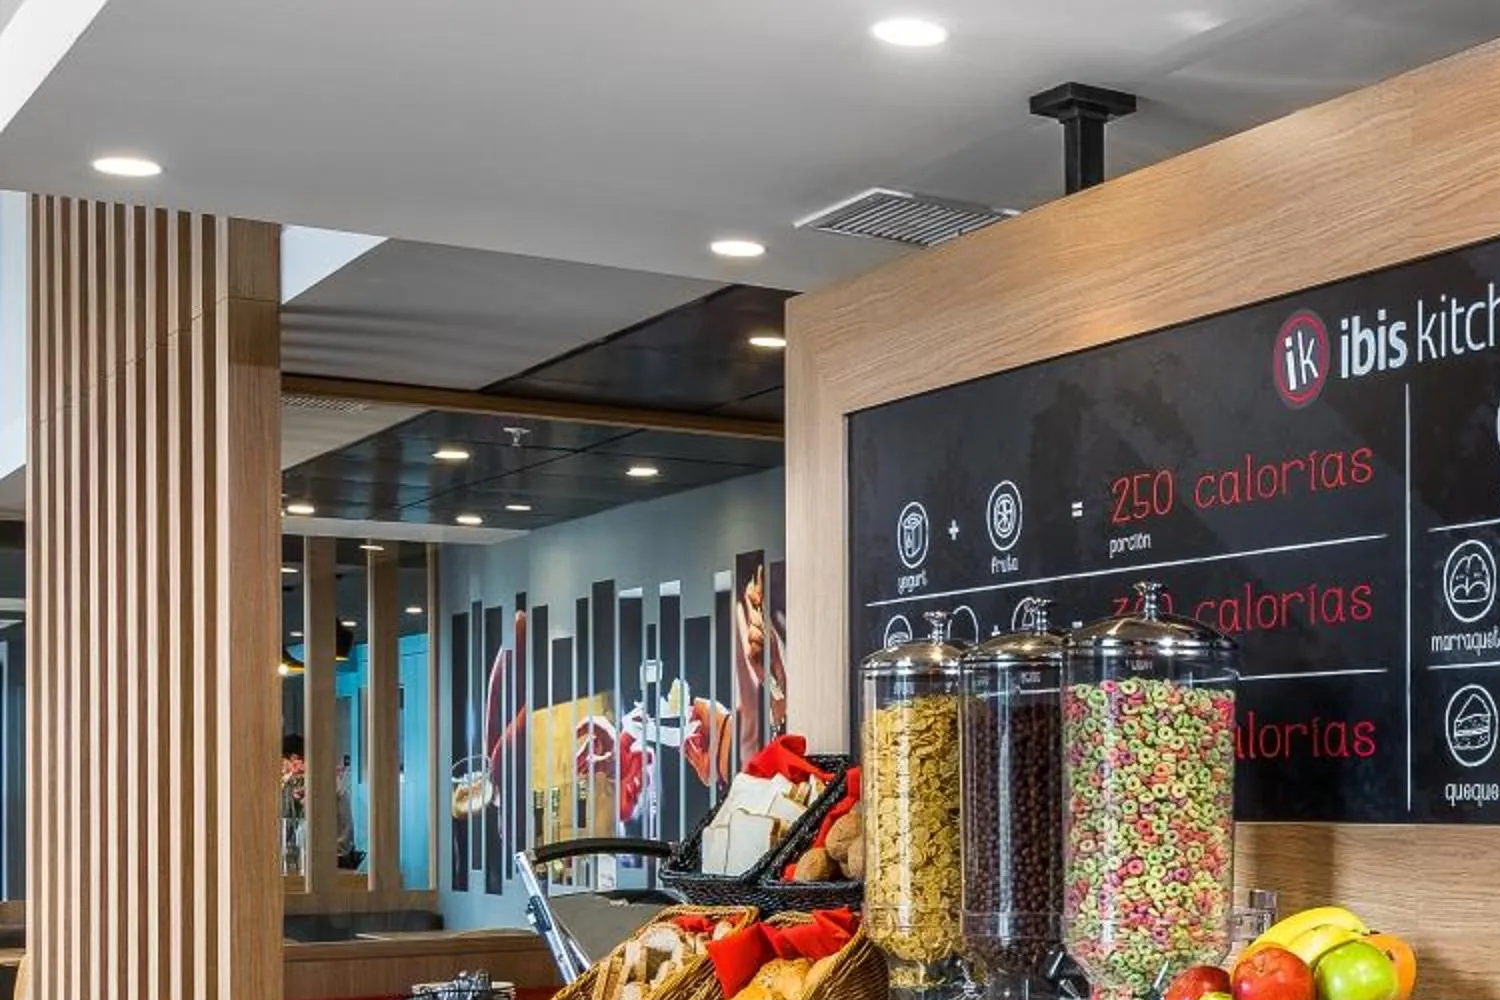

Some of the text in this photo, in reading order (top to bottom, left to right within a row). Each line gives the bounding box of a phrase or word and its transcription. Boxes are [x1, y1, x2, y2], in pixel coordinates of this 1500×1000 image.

[1284, 328, 1320, 392] ik
[1340, 308, 1409, 379] ibis
[1111, 470, 1174, 525] 250
[1192, 447, 1375, 509] calorías
[990, 554, 1019, 575] fruta
[1109, 531, 1152, 559] porción
[1236, 709, 1377, 760] lorías
[1444, 782, 1500, 808] queque
